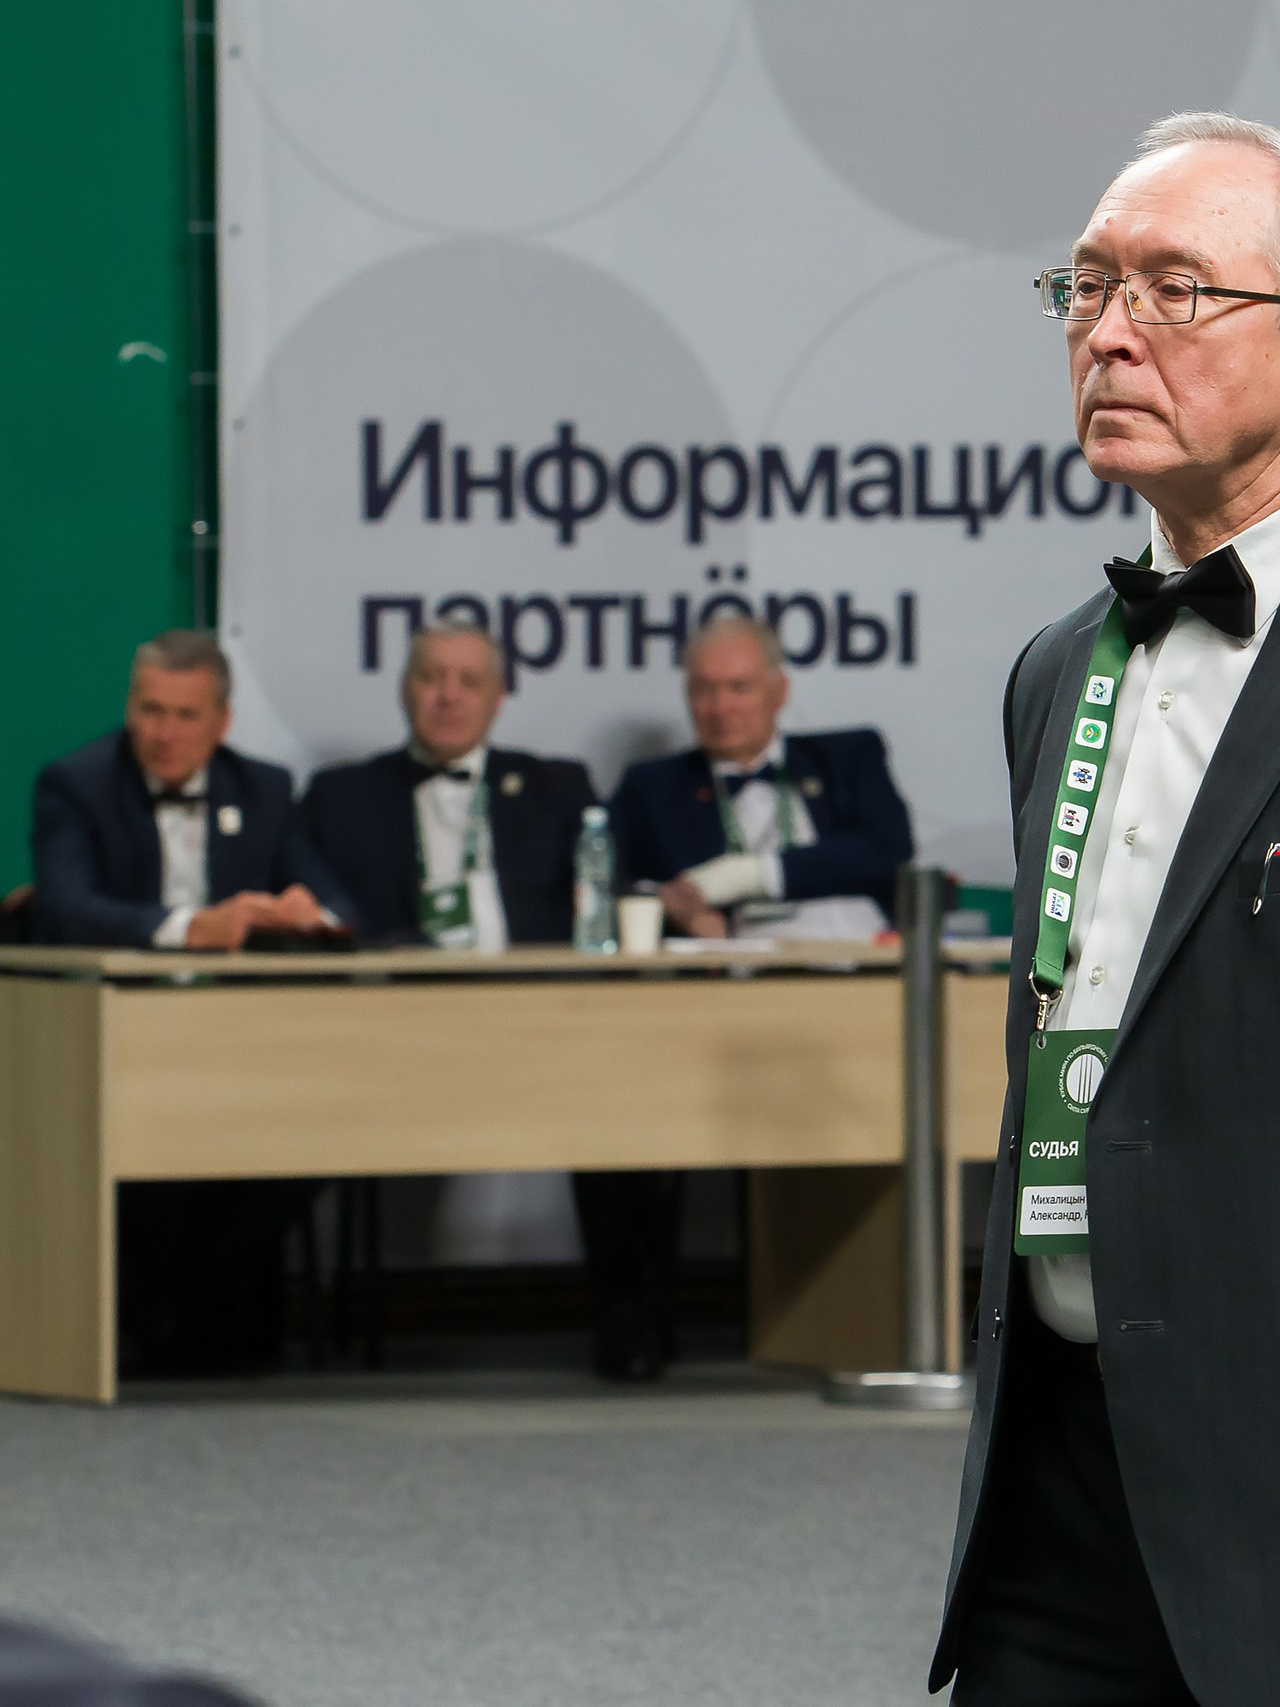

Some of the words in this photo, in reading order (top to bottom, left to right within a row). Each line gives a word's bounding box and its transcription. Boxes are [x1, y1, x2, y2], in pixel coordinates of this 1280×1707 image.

[1029, 1140, 1079, 1160] СУДЬЯ
[1031, 1194, 1086, 1206] Михалицын
[1029, 1209, 1083, 1222] Александр,
